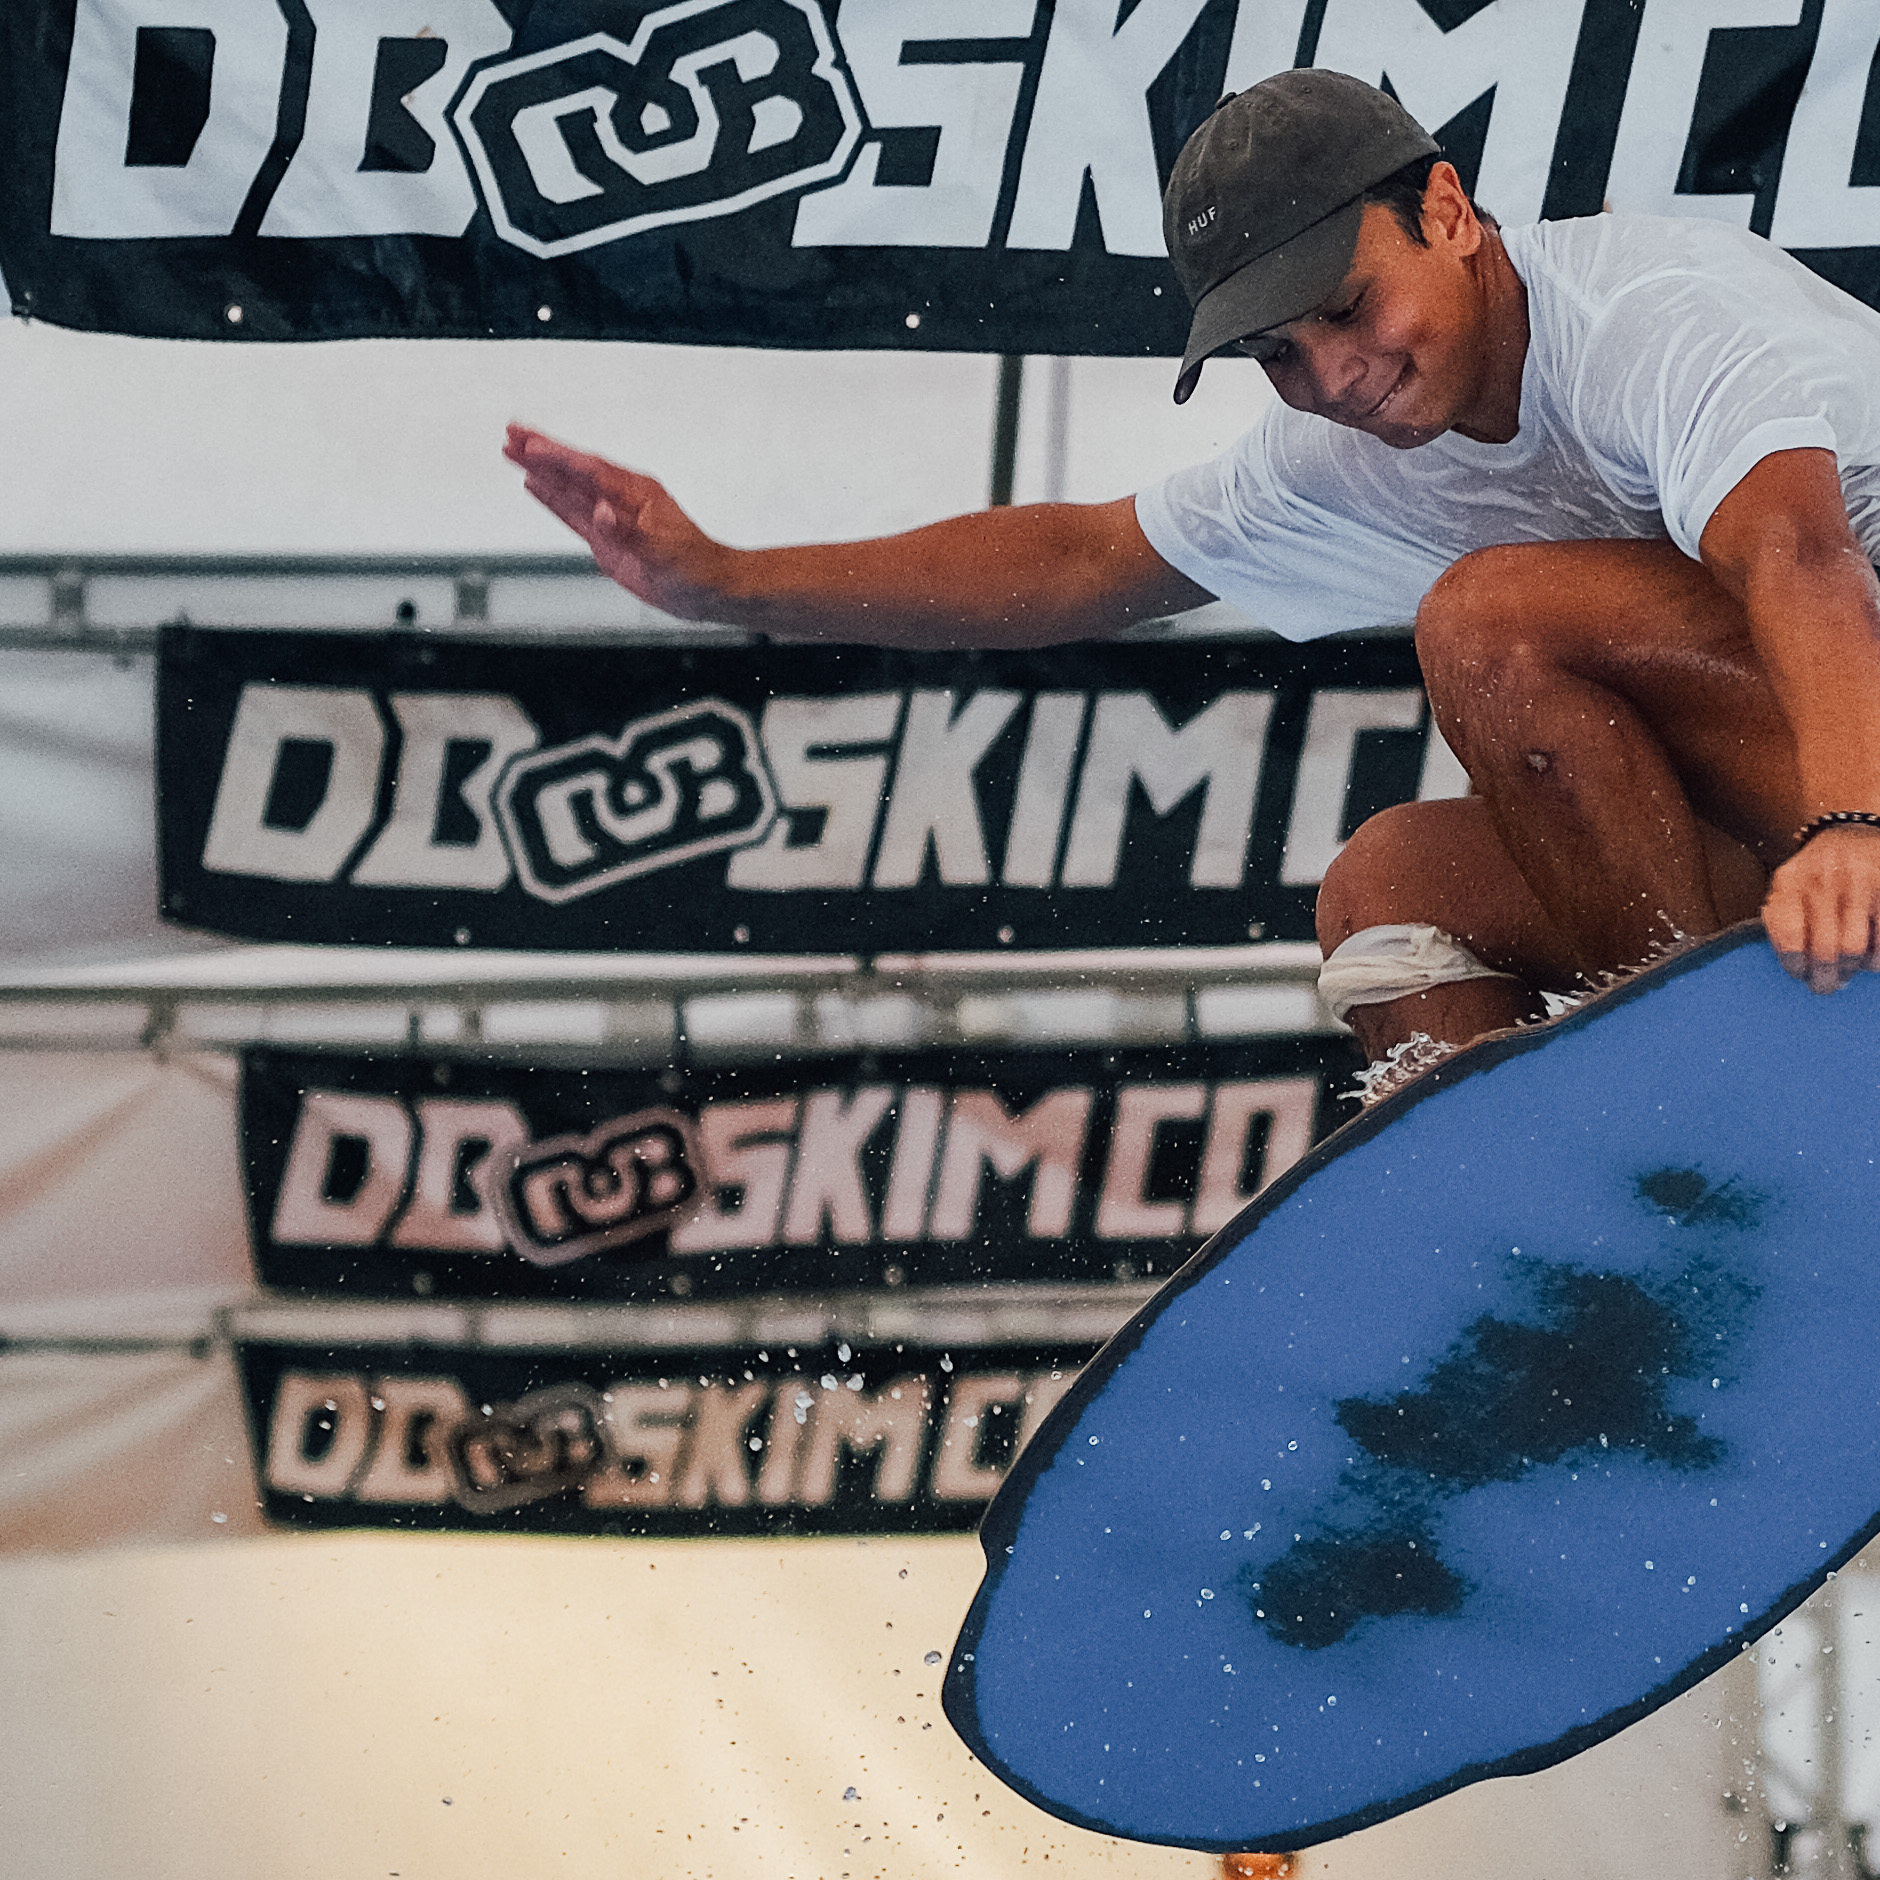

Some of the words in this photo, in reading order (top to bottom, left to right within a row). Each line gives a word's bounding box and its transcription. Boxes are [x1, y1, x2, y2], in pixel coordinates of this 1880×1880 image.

[1188, 206, 1216, 236] HUF
[202, 681, 543, 894] DB
[1279, 686, 1472, 886] C
[270, 1089, 530, 1251] DB
[267, 1372, 470, 1505] DB
